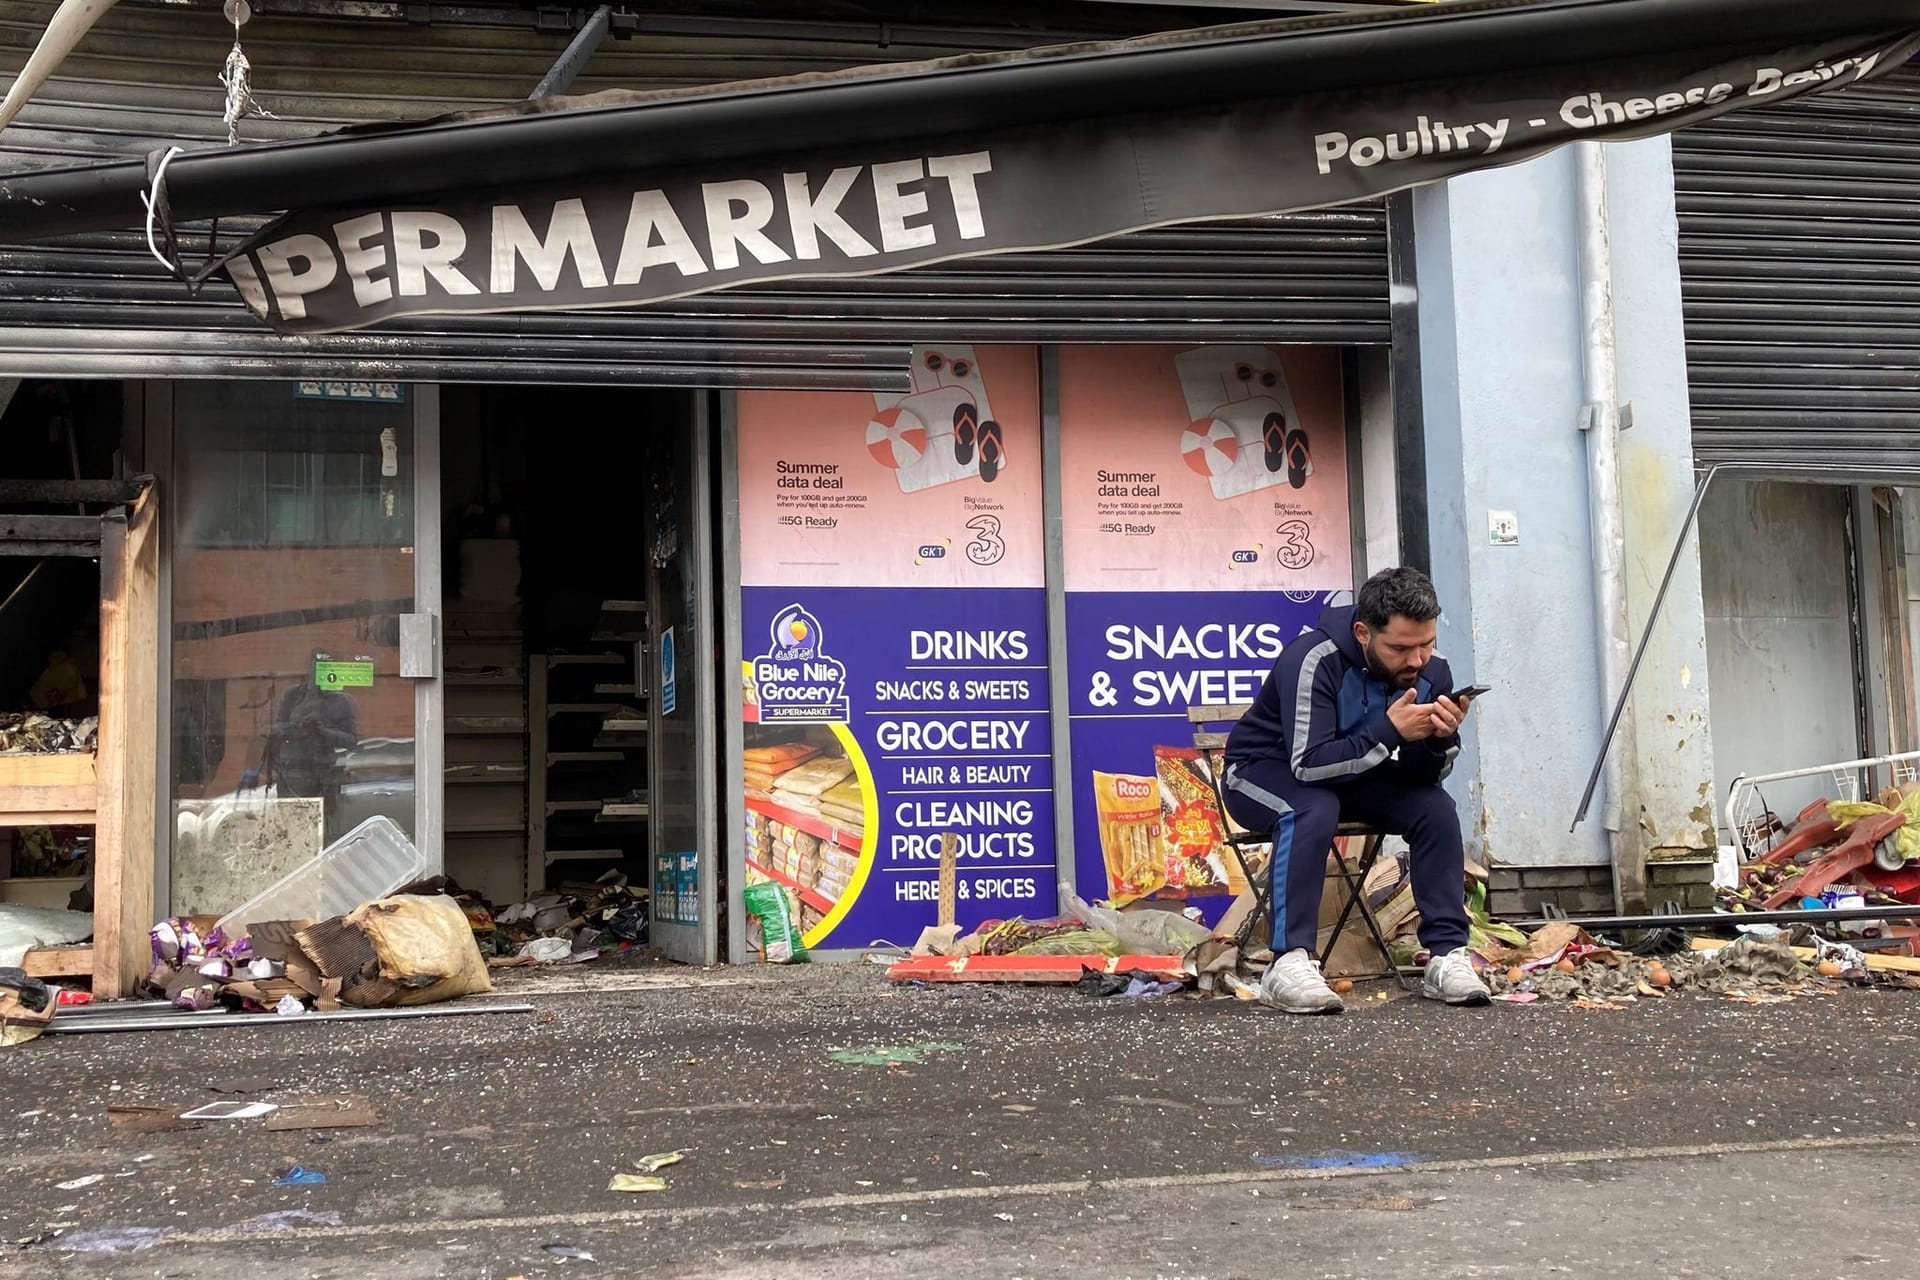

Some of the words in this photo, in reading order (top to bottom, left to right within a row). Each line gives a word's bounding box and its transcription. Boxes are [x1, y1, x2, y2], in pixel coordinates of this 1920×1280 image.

[1314, 115, 1510, 174] Poultry
[776, 460, 839, 474] Summer
[1097, 469, 1156, 483] Summer
[777, 475, 809, 489] data
[812, 476, 844, 489] deal
[1098, 484, 1128, 497] data
[1131, 484, 1160, 497] deal
[776, 494, 789, 502] Pay
[1097, 502, 1109, 510] Pay
[805, 516, 838, 528] Ready
[1125, 524, 1156, 535] Ready
[965, 514, 1006, 566] 3
[1276, 519, 1315, 570] 3
[920, 546, 944, 558] GKT
[1234, 552, 1256, 562] GKT
[910, 630, 1028, 661] DRINKS
[1105, 623, 1283, 661] SNACKS
[759, 663, 800, 682] Blue
[803, 663, 839, 682] Nile
[762, 683, 836, 704] Grocery
[875, 680, 944, 701] SNACKS
[948, 681, 960, 700] &
[965, 680, 1030, 701] SWEETS
[1088, 670, 1119, 708] &
[773, 708, 832, 716] SUPERMARKET
[876, 720, 1030, 751] GROCERY
[902, 766, 944, 785] HAIR
[949, 765, 961, 783] &
[966, 765, 1032, 784] BEAUTY
[1117, 780, 1150, 797] Roco
[895, 800, 1034, 828] CLEANING
[891, 833, 1035, 861] PRODUCTS
[895, 880, 941, 902] HERB
[958, 881, 970, 900] &
[974, 878, 1036, 900] SPICES
